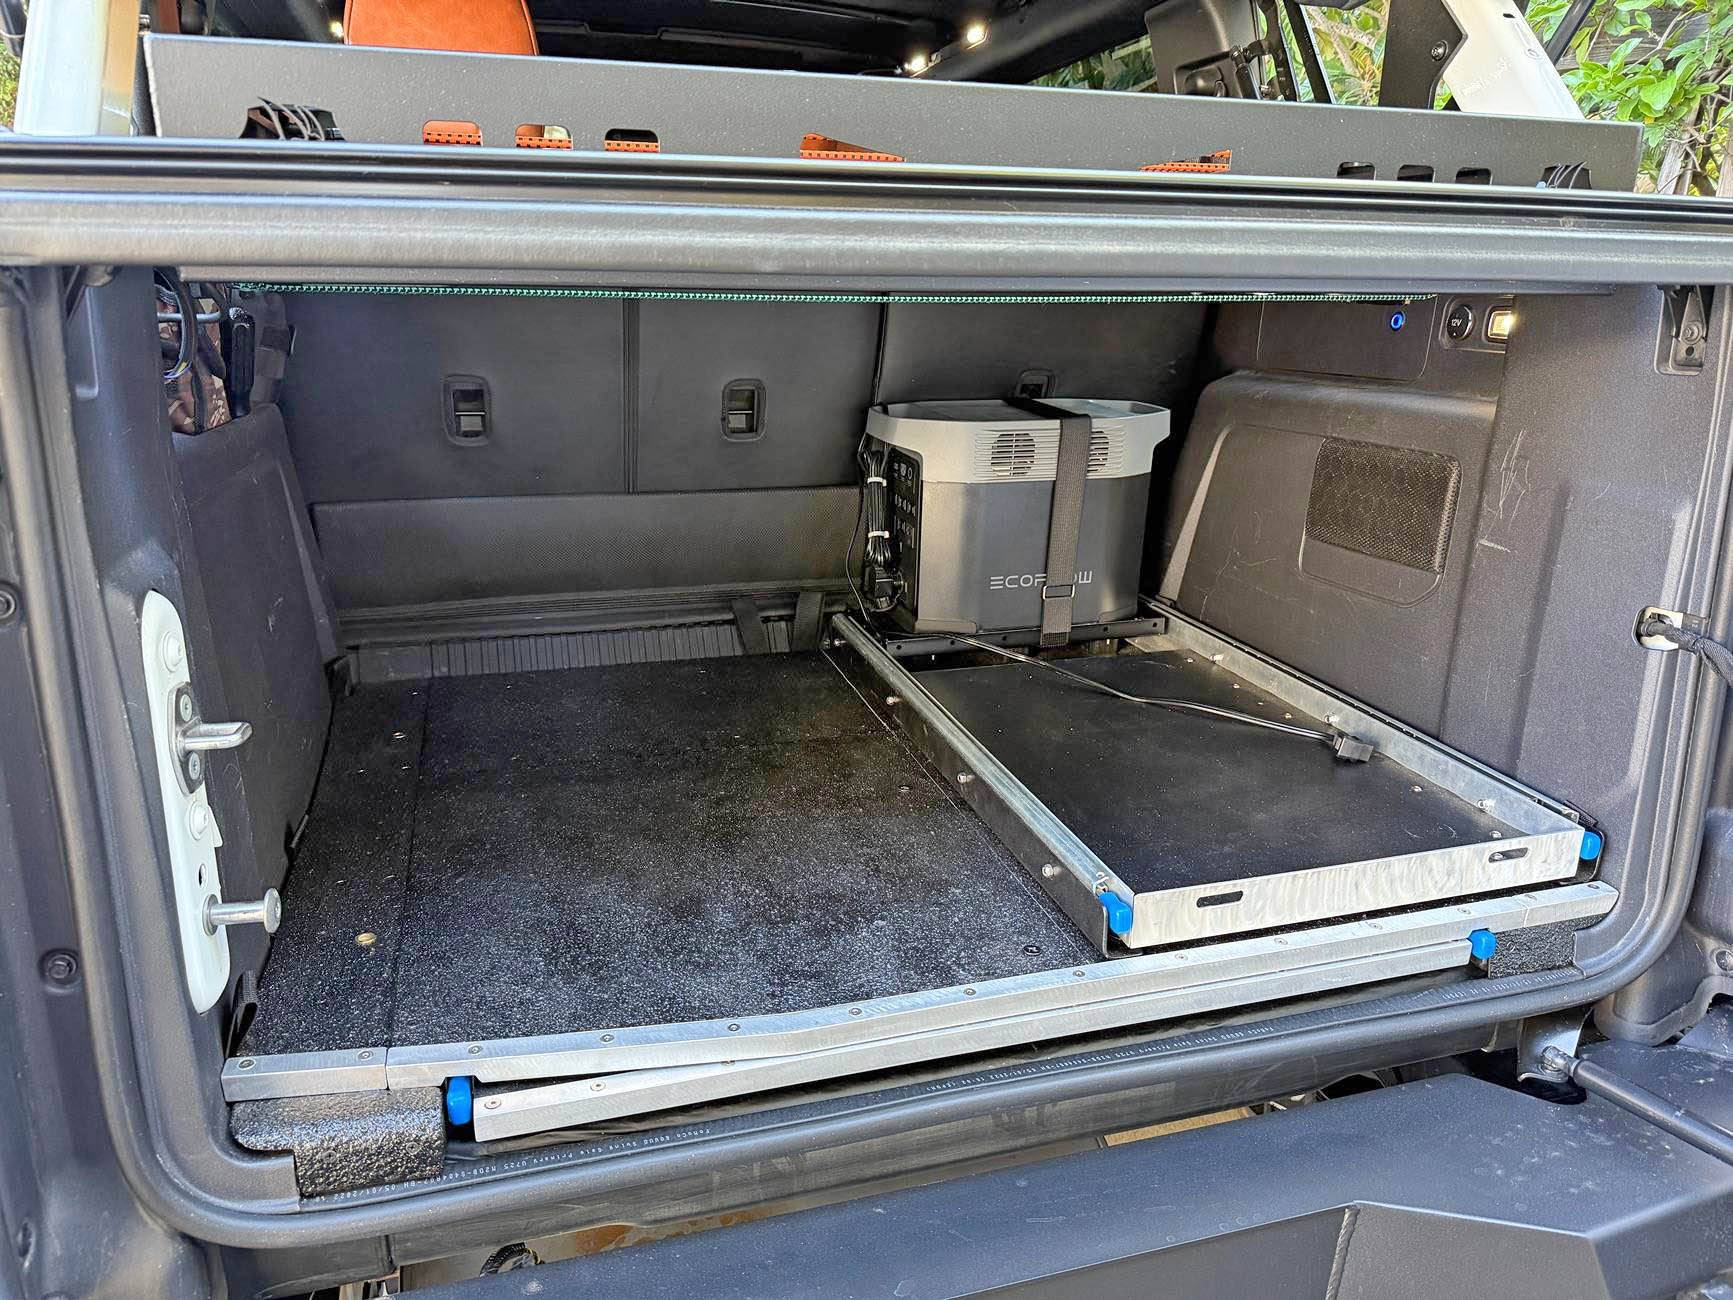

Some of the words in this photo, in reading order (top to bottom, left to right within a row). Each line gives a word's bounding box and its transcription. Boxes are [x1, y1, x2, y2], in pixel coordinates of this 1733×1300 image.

[1451, 318, 1462, 327] 12V
[990, 570, 1092, 590] ECOFW
[534, 1152, 573, 1164] Primary
[504, 1160, 526, 1170] U725
